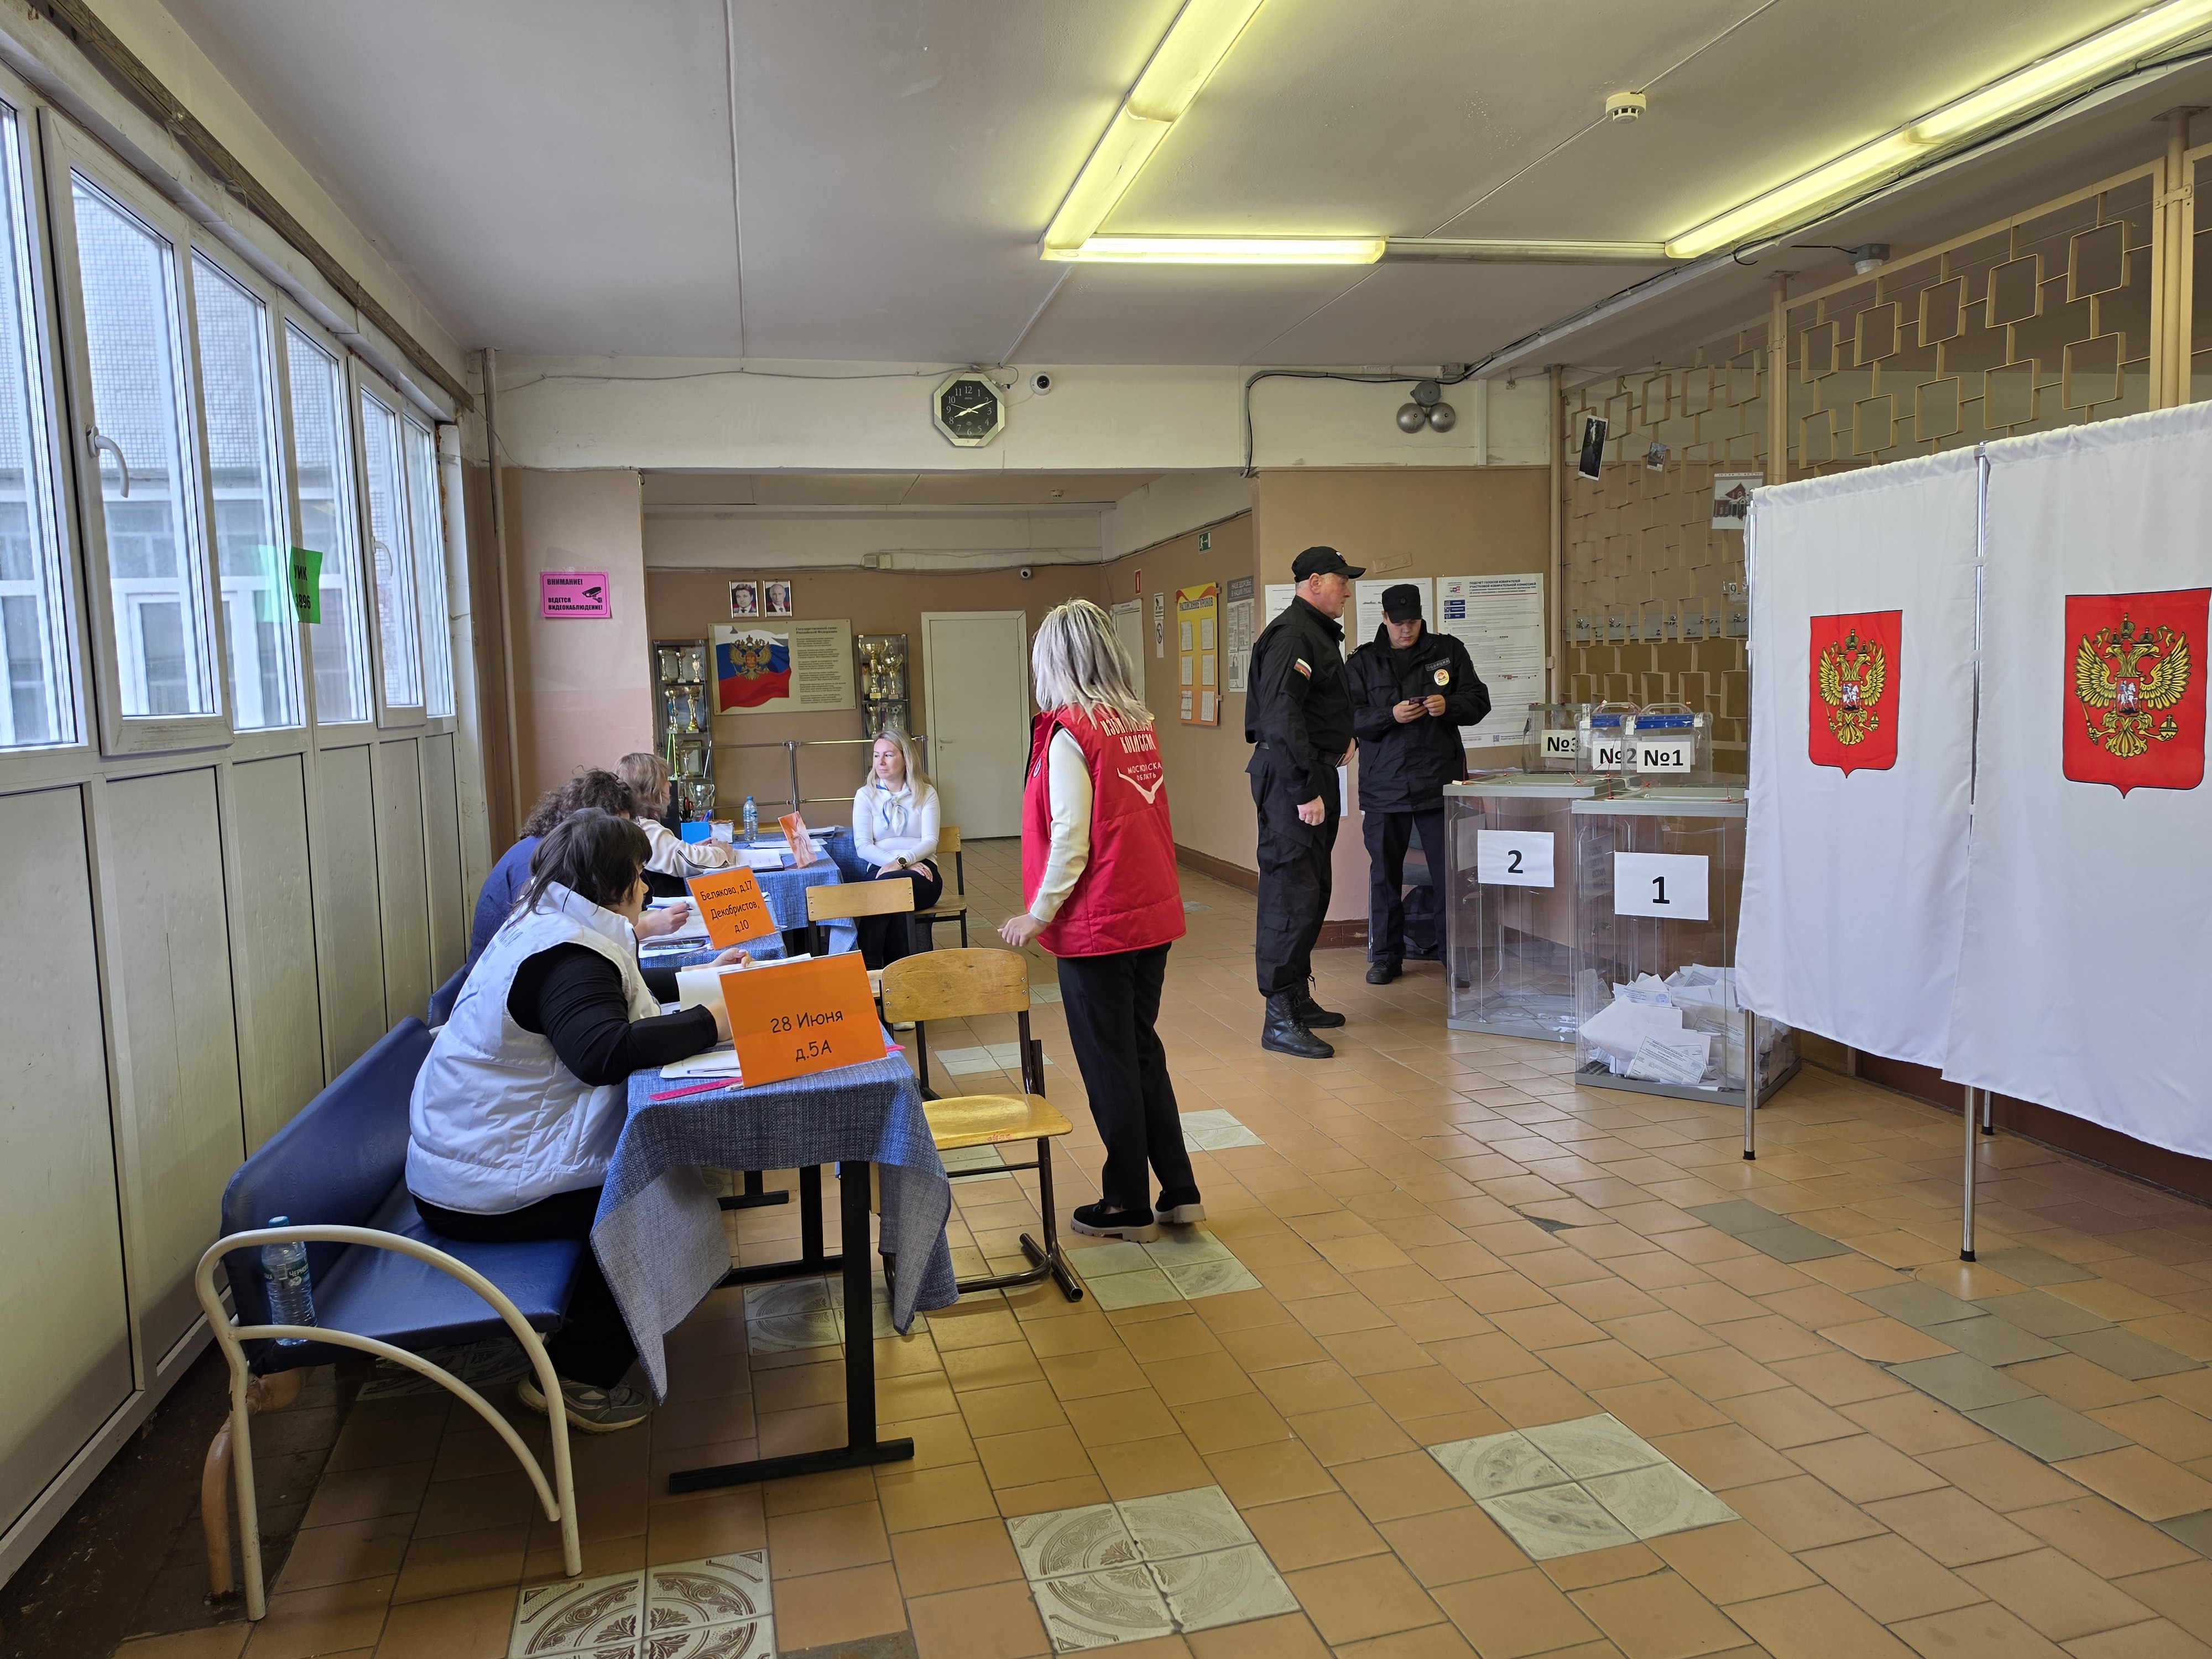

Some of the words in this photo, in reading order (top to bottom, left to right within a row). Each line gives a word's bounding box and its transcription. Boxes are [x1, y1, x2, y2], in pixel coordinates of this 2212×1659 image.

[987, 407, 992, 415] 3
[294, 564, 307, 581] УИК
[1730, 585, 1736, 595] 9
[295, 593, 311, 609] 3896
[1427, 659, 1449, 669] ПОЛИЦИЯ
[1547, 737, 1578, 752] №3
[1600, 748, 1637, 764] №2
[1644, 749, 1684, 766] №1
[1128, 762, 1162, 774] МОСКОСКА
[1507, 850, 1524, 874] 2
[700, 886, 739, 901] Белякова,
[739, 880, 752, 893] д.17
[1652, 876, 1670, 904] 1
[710, 901, 760, 920] Декабристов,
[734, 919, 749, 933] д.10
[770, 1016, 792, 1033] 28
[796, 1010, 843, 1029] Июня
[795, 1040, 832, 1062] д.5А
